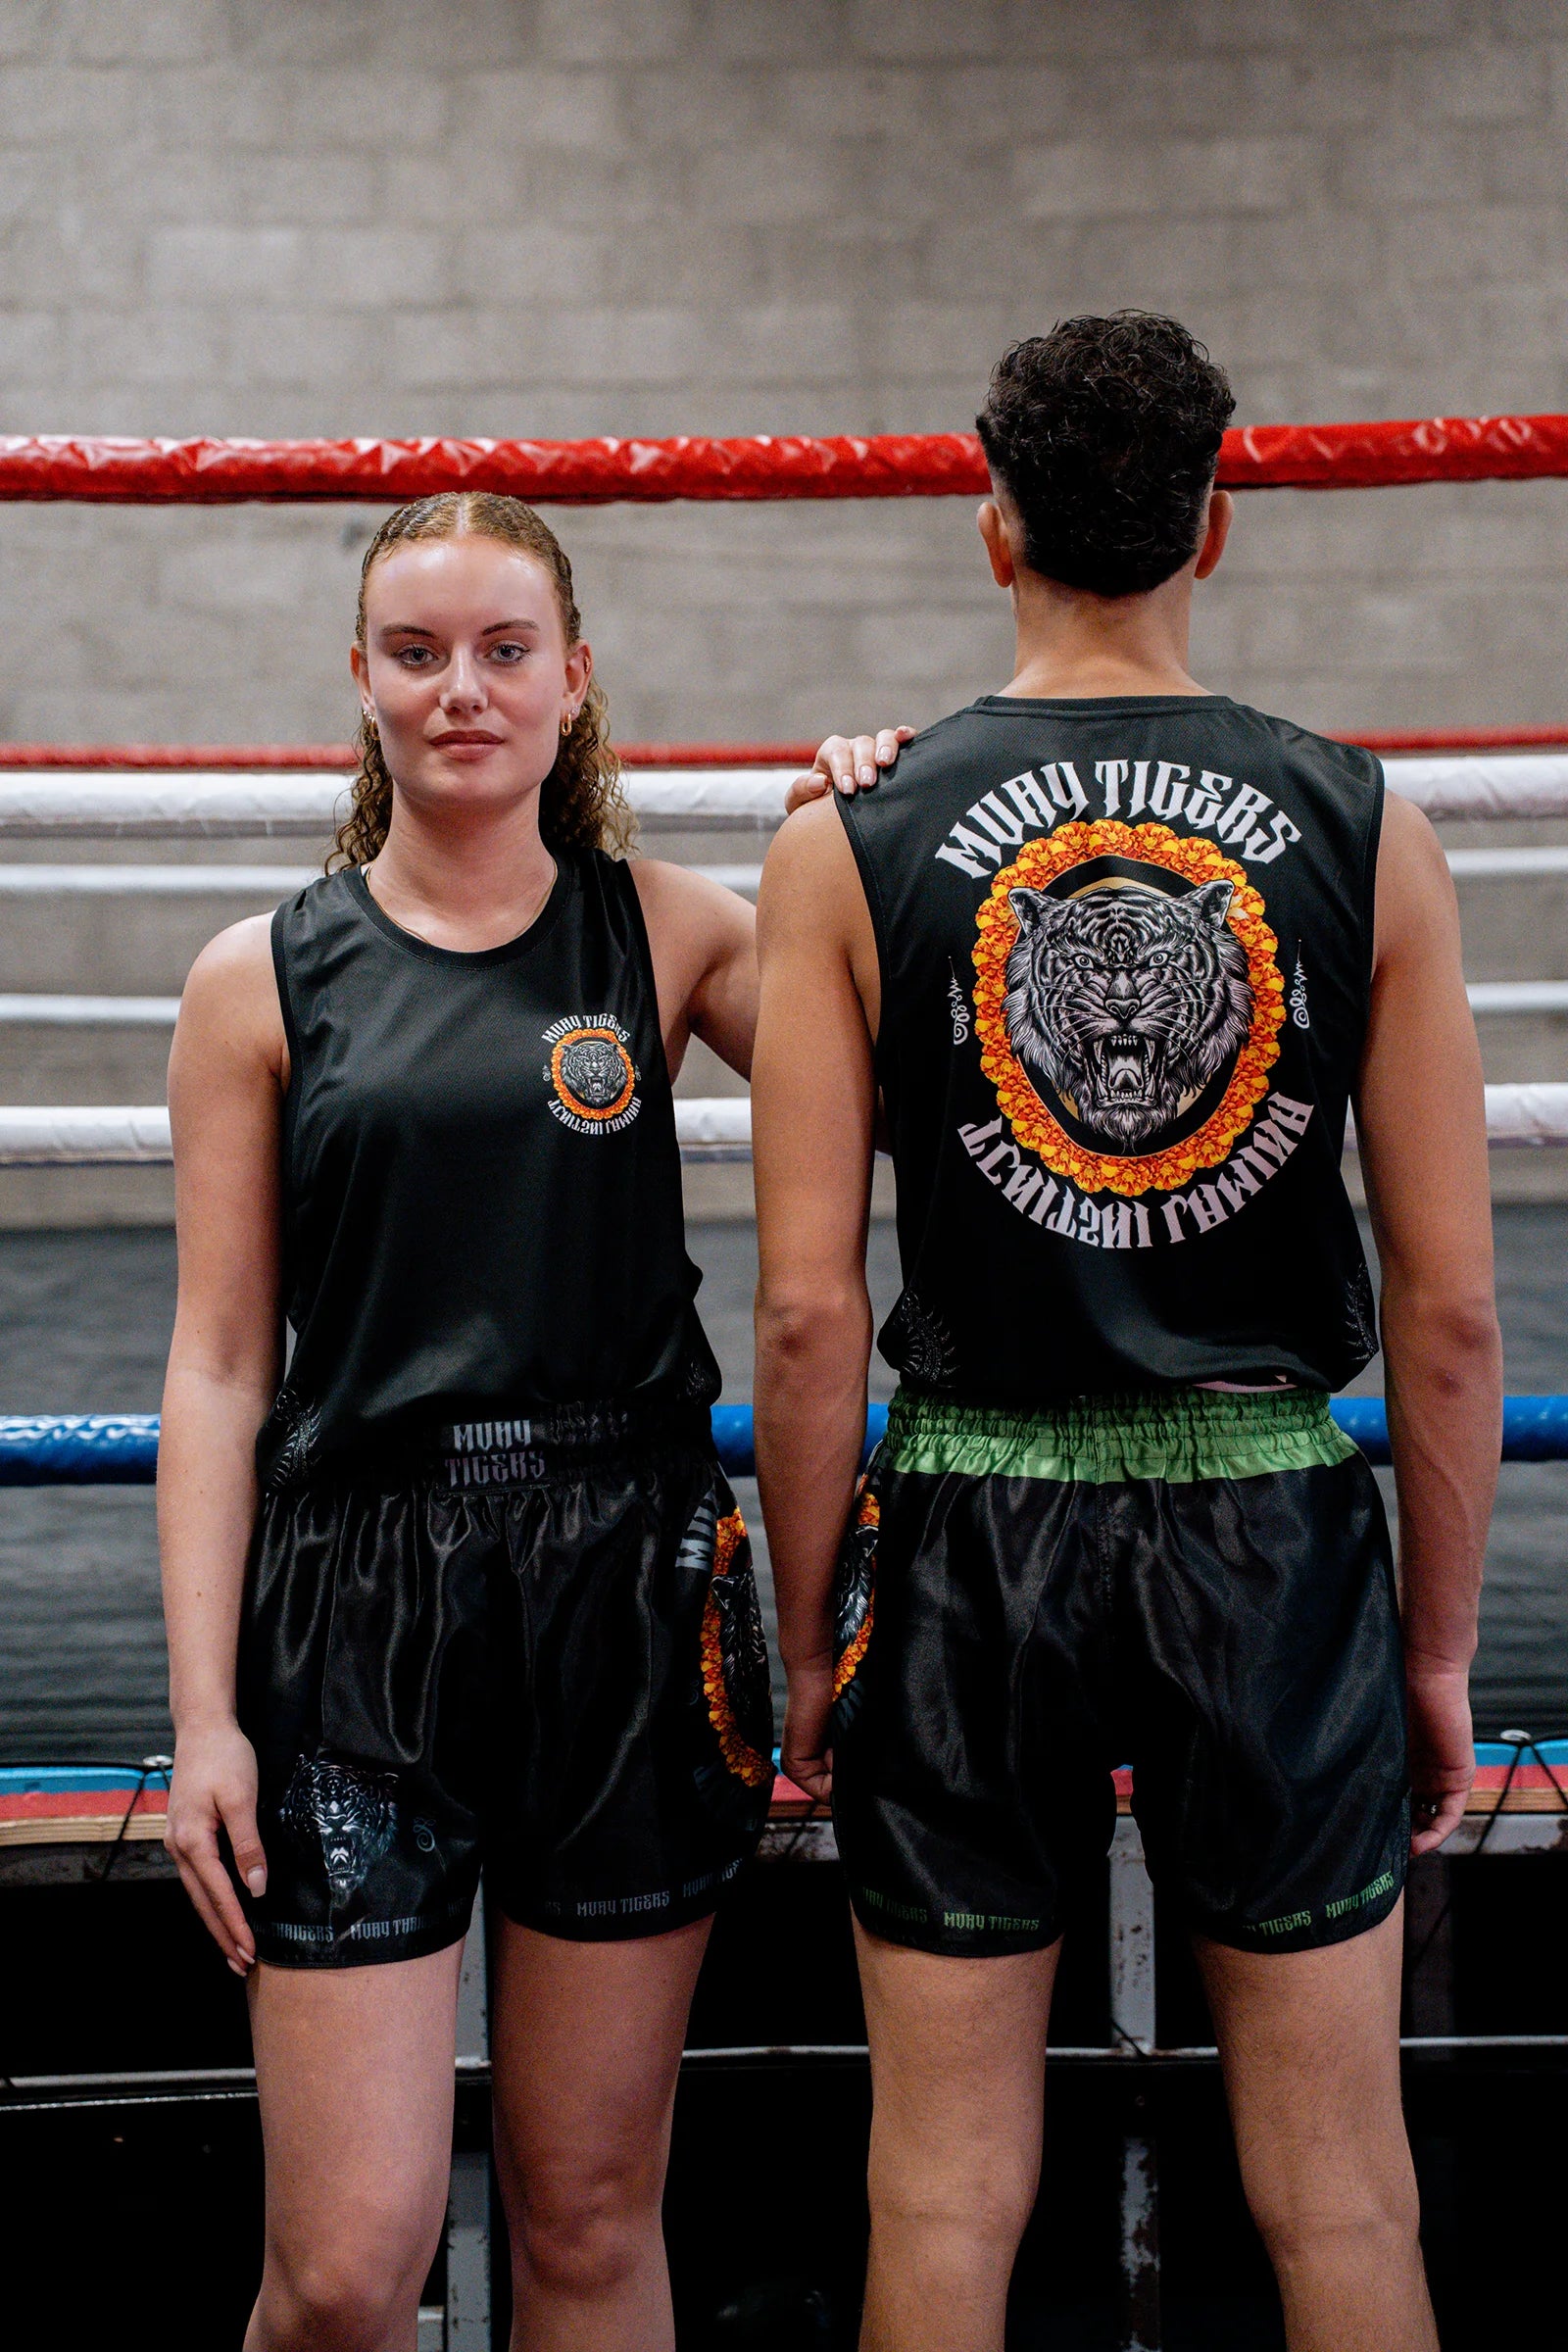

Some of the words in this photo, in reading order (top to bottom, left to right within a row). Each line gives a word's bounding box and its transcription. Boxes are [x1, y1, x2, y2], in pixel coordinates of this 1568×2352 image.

[934, 760, 1090, 879] MUAY
[1094, 759, 1303, 865] TIGERS
[541, 1014, 582, 1044] MUAY
[582, 1012, 631, 1044] TIGERS
[453, 1419, 532, 1452] MUAY
[444, 1450, 546, 1488] TIGERS
[576, 1899, 616, 1917] MUAY
[619, 1890, 670, 1914] TIGERS
[1325, 1893, 1359, 1919] MUAY
[350, 1921, 390, 1941] MUAY
[944, 1911, 985, 1930] MUAY
[988, 1916, 1040, 1932] TIGERS
[1258, 1910, 1312, 1936] TIGERS
